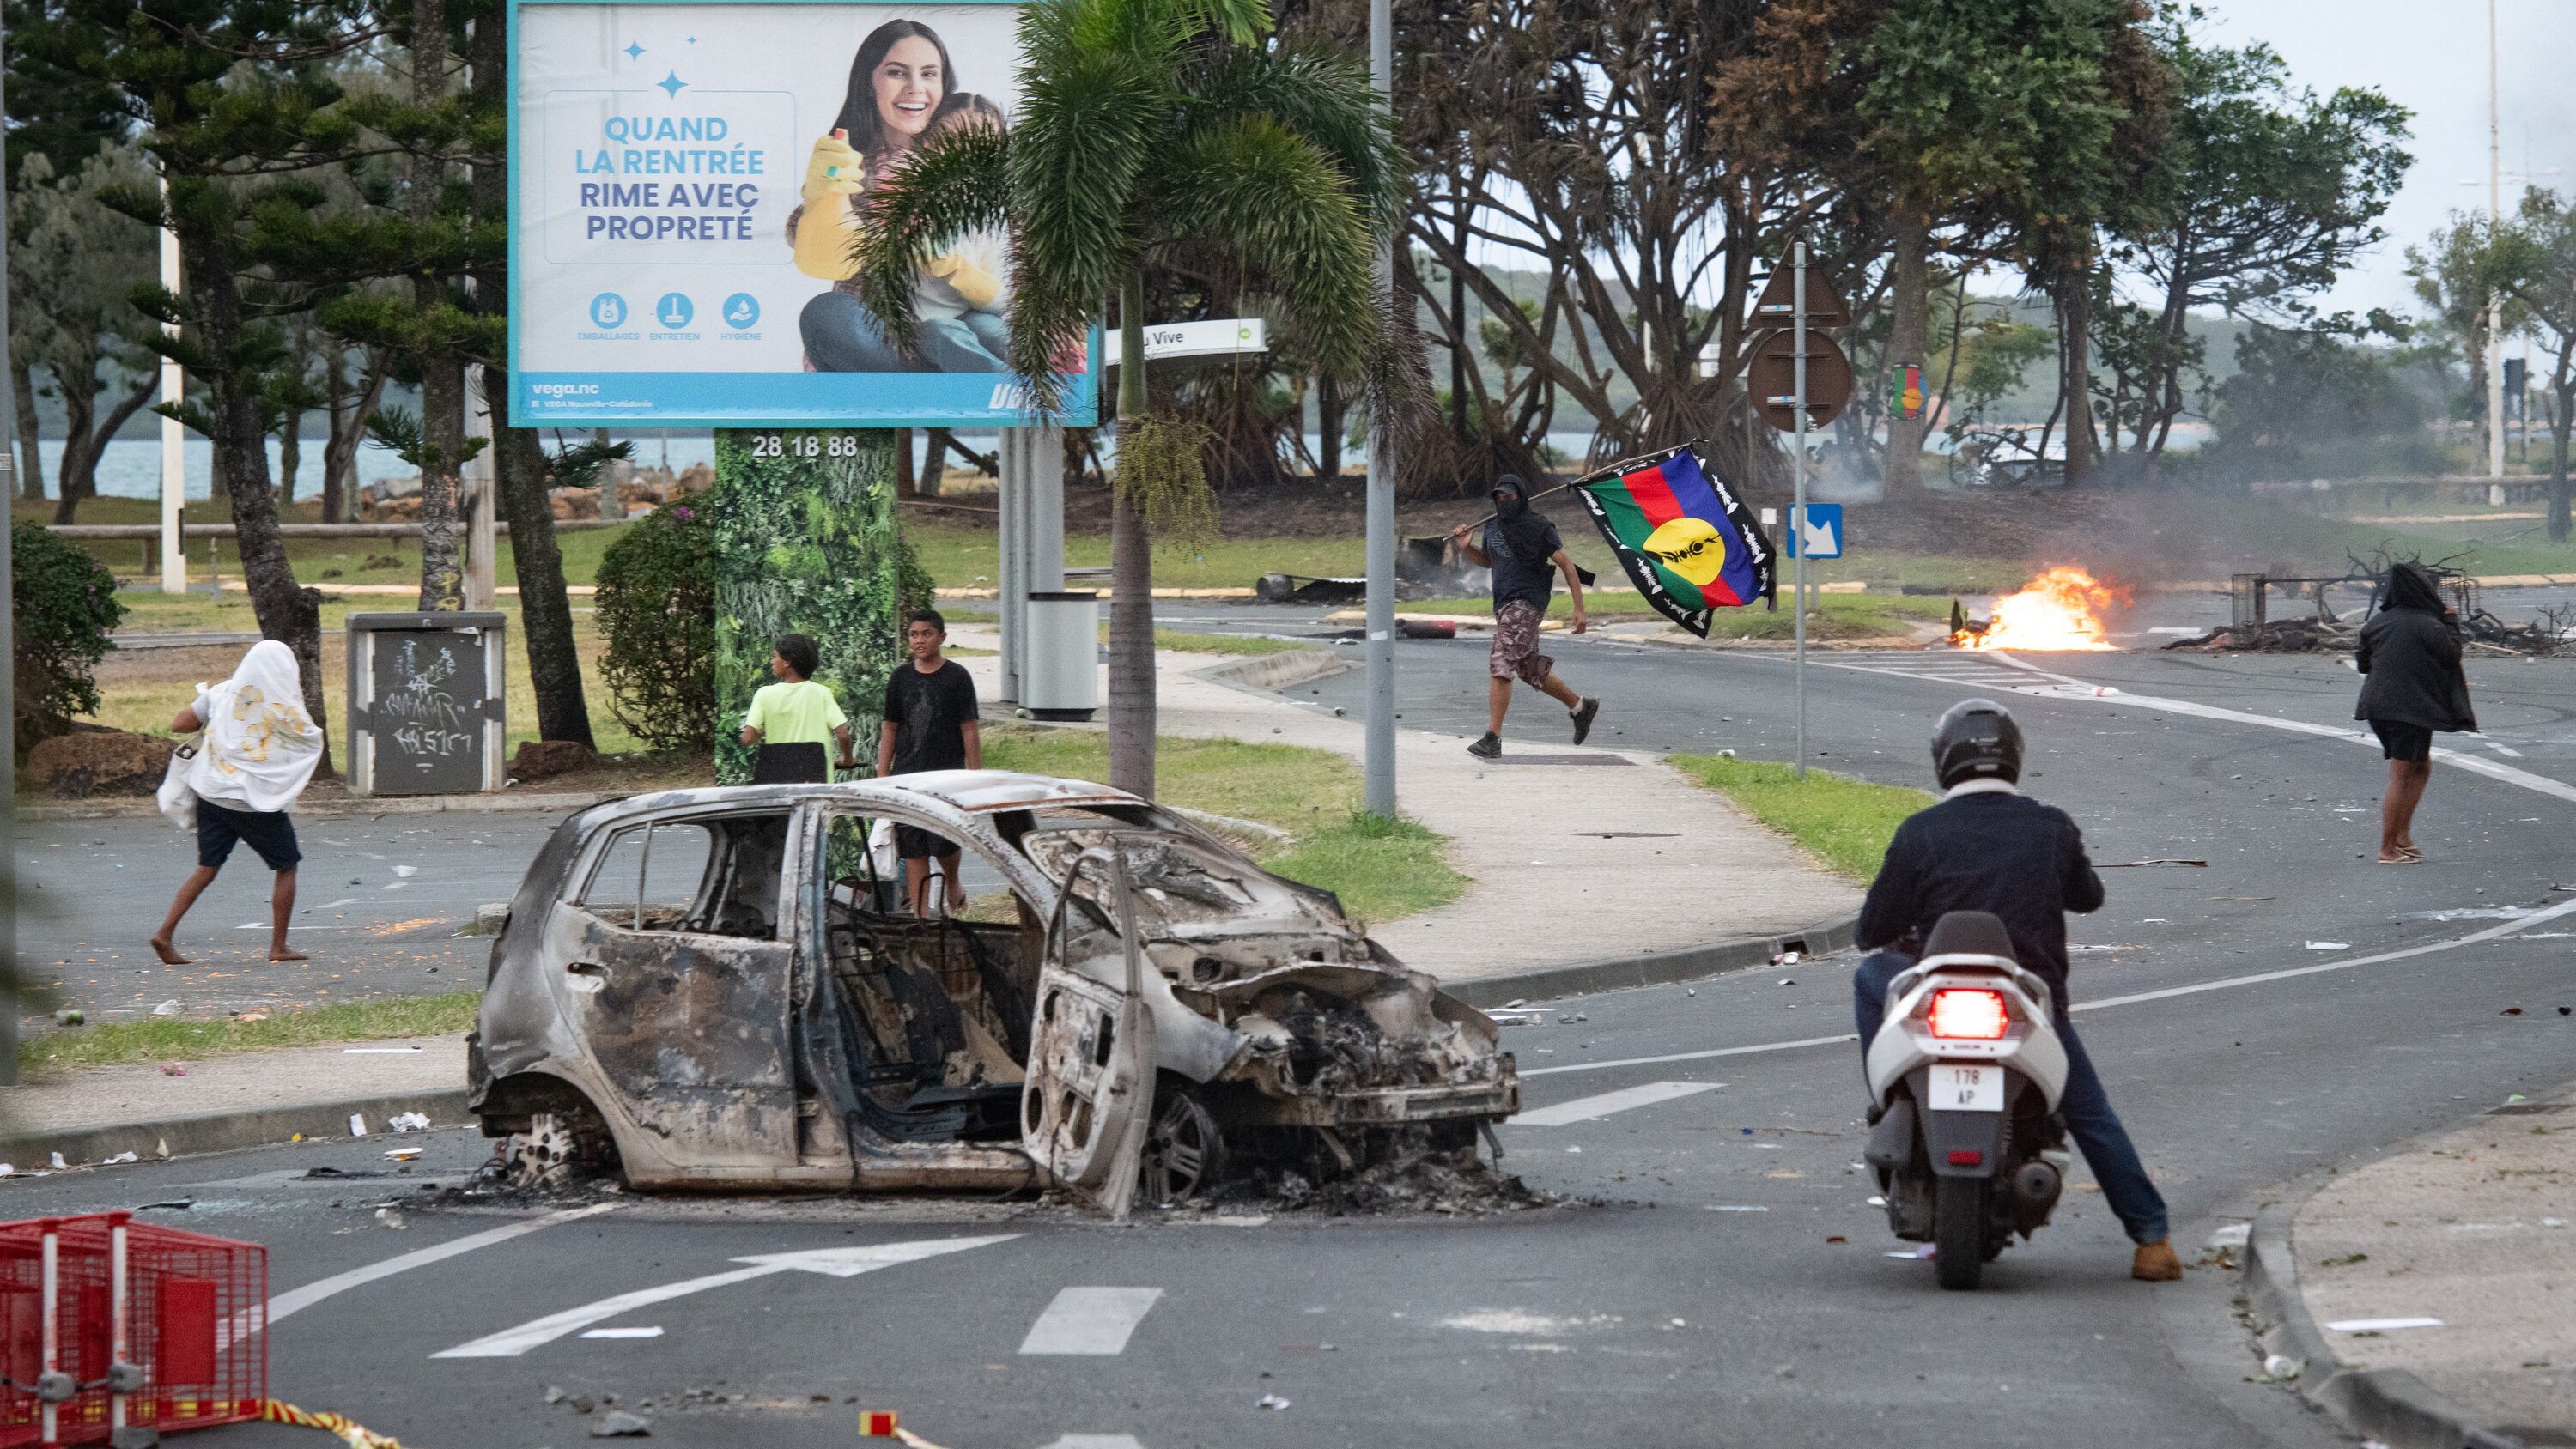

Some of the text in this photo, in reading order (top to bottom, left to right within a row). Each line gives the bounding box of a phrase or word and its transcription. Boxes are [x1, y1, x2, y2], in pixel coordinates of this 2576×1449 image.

[605, 116, 728, 144] QUAND
[576, 142, 764, 175] LA RENTRÉE
[580, 183, 759, 208] RIME AVEC
[587, 209, 753, 240] PROPRETÉ
[577, 332, 641, 341] EMBALLAGES
[649, 332, 701, 341] ENTRETIEN
[1152, 331, 1184, 345] Vive
[532, 383, 599, 398] vega.nc
[752, 435, 858, 457] 28 18 88
[1954, 1070, 1980, 1086] 178
[1958, 1090, 1976, 1105] AP
